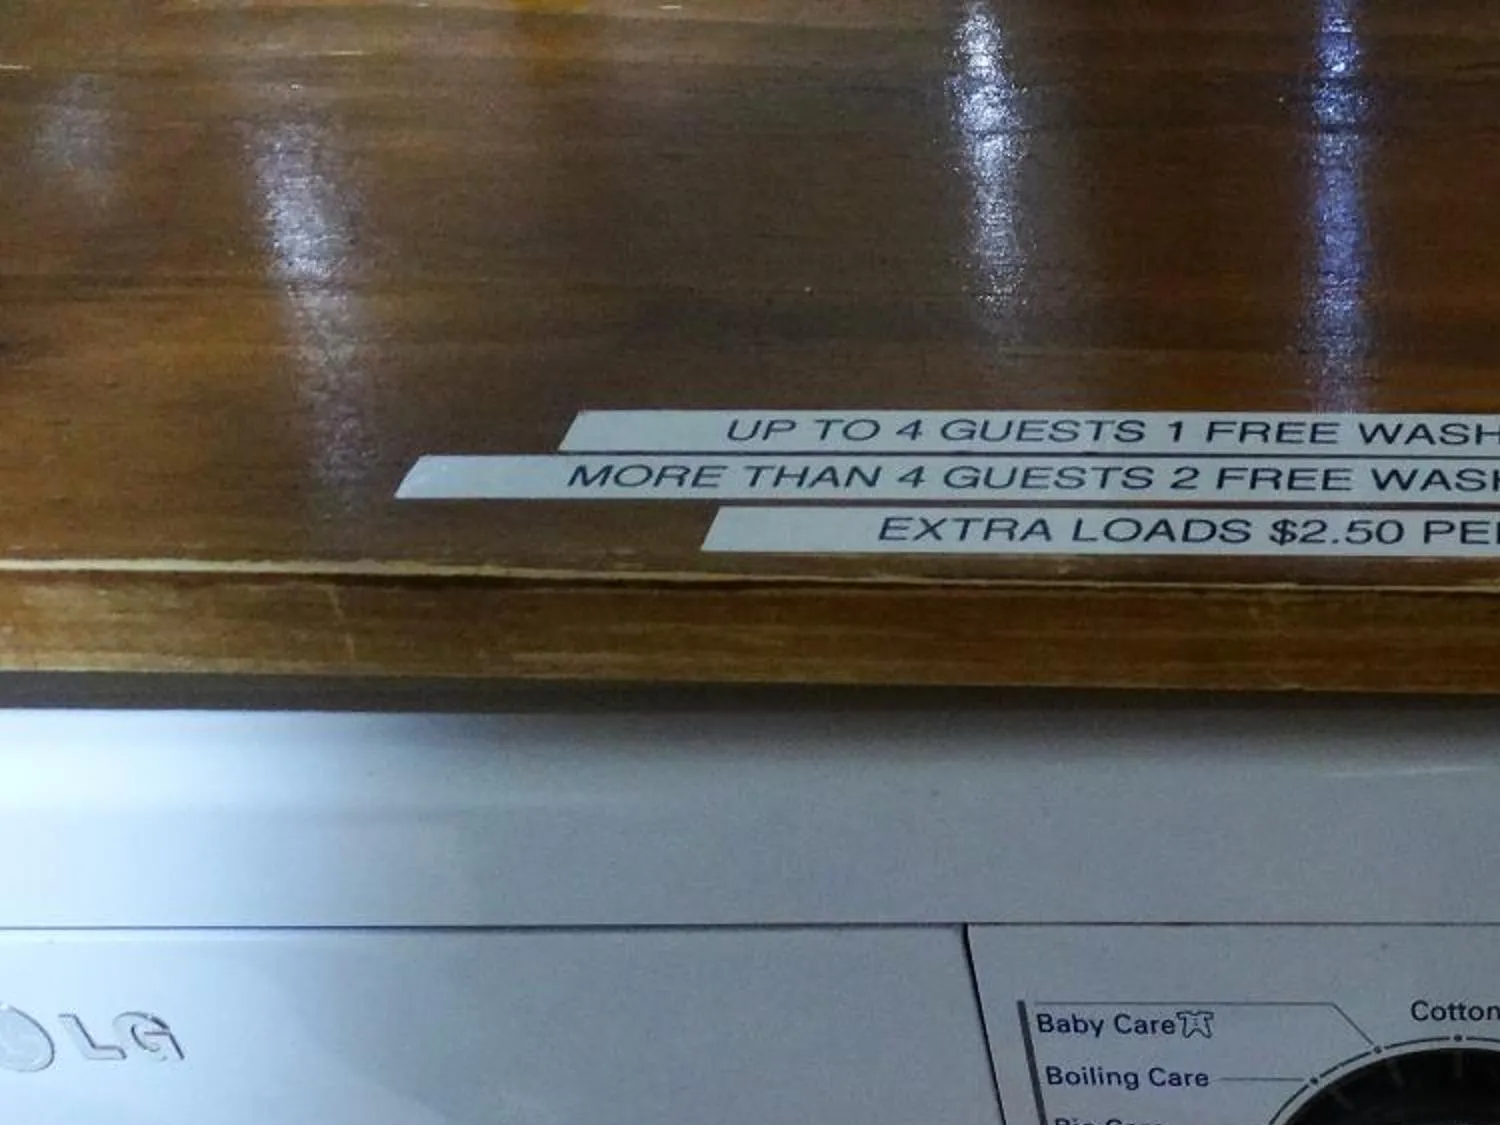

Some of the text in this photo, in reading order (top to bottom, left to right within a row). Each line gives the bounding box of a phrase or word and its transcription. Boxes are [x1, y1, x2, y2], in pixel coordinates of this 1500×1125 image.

[726, 419, 797, 442] UP
[815, 418, 881, 442] TO
[895, 419, 923, 441] 4
[940, 419, 1146, 443] GUESTS
[1168, 420, 1183, 443] 1
[1205, 421, 1340, 445] FREE
[567, 464, 728, 488] MORE
[745, 465, 883, 489] THAN
[897, 465, 925, 489] 4
[943, 465, 1155, 490] GUESTS
[1170, 466, 1200, 490] 2
[1216, 467, 1351, 491] FREE
[878, 517, 1052, 542] EXTRA
[1072, 517, 1252, 544] LOADS
[1269, 518, 1405, 547] $2.50
[59, 1011, 186, 1061] LG
[1036, 1013, 1176, 1038] Baby Care
[1045, 1065, 1209, 1091] Boiling Care
